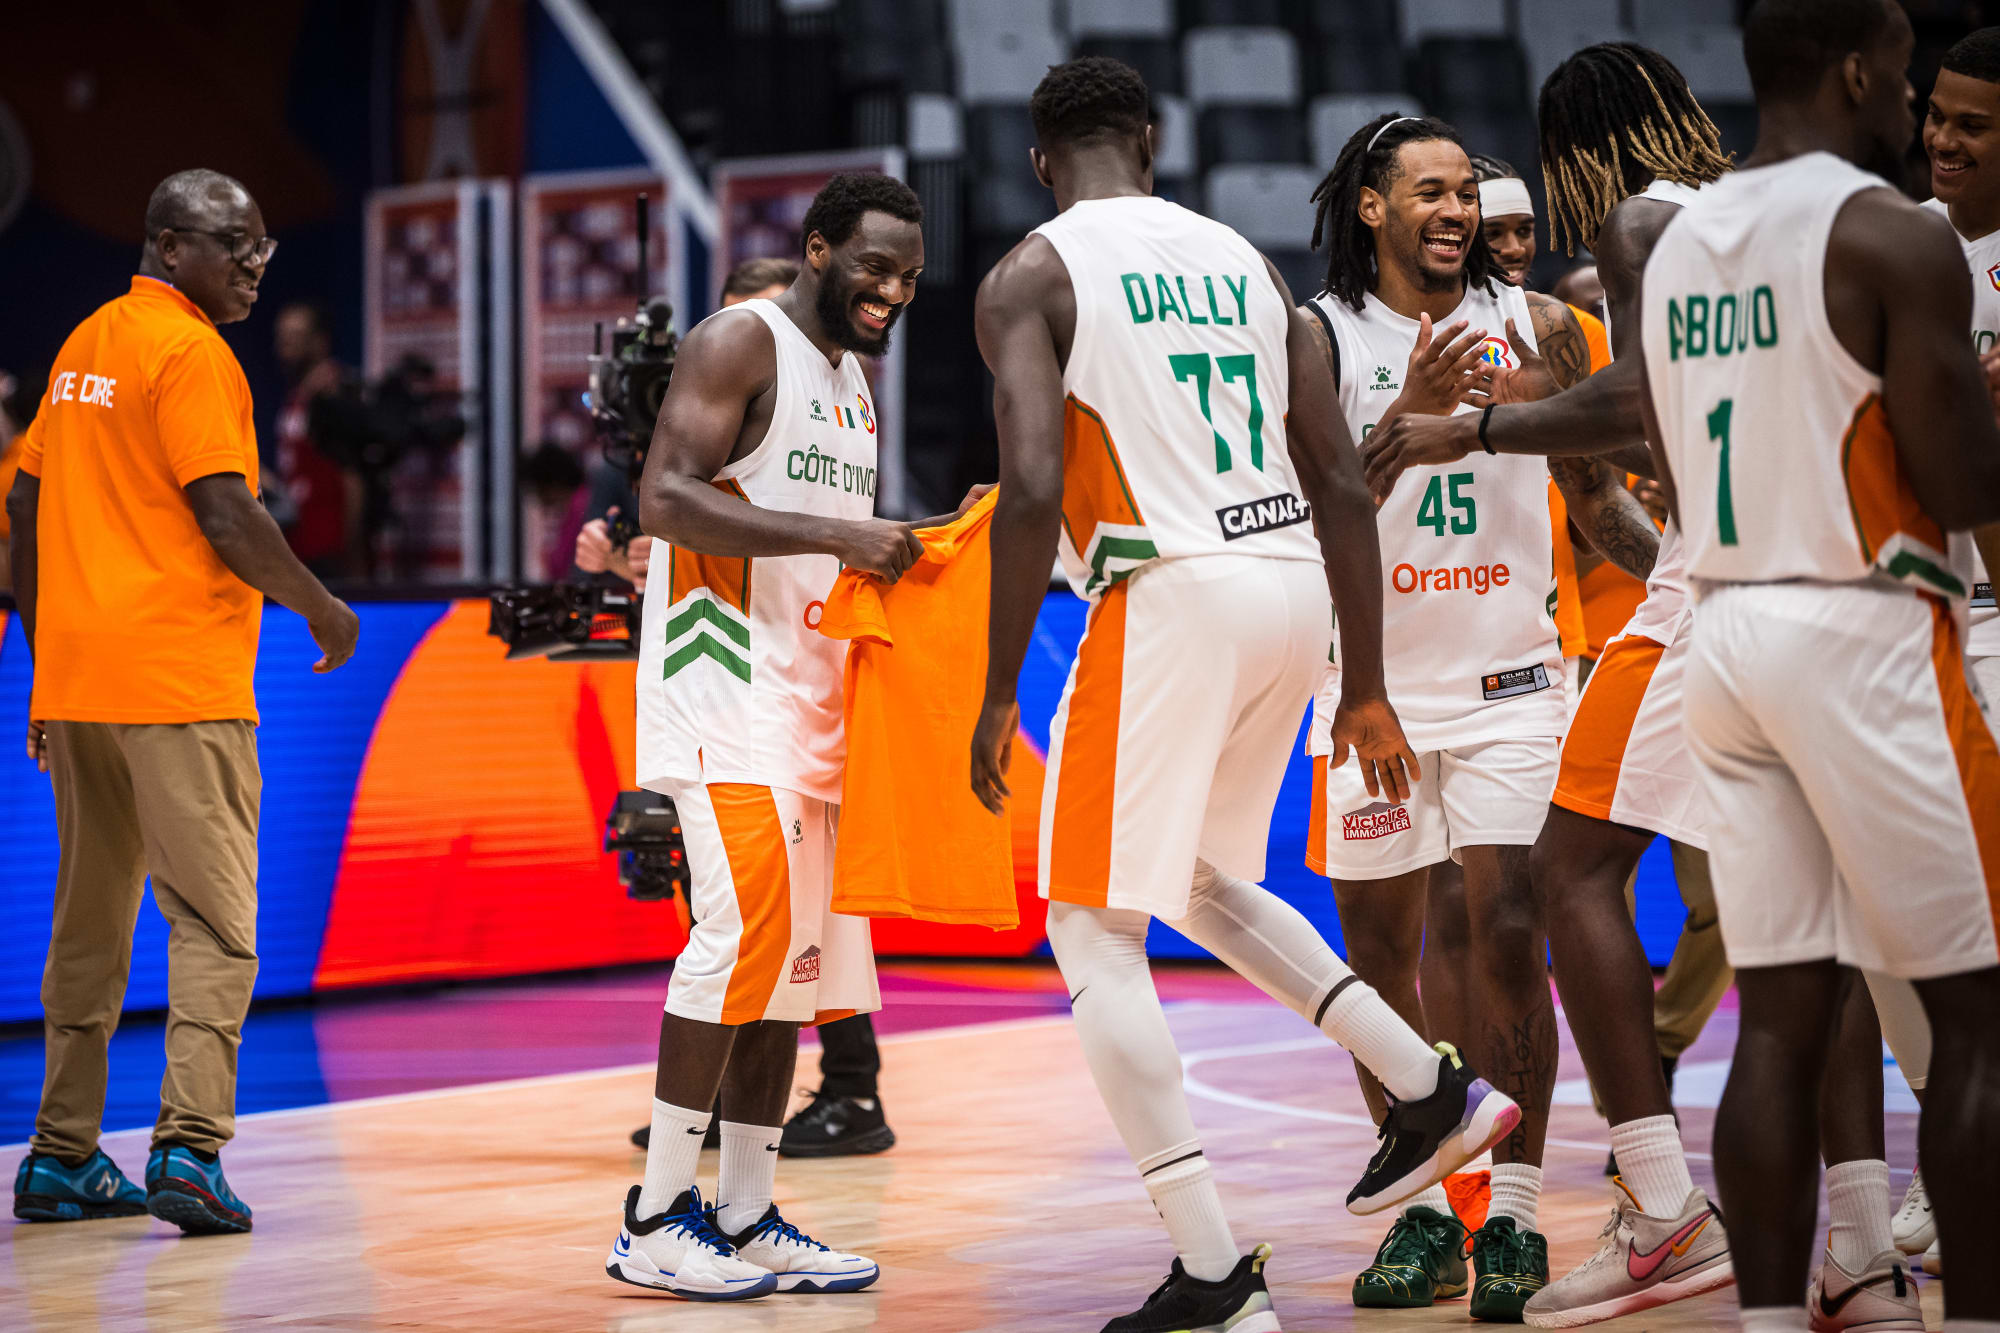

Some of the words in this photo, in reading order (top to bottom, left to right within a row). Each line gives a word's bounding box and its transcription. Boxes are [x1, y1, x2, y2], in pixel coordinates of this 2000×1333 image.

[1120, 272, 1248, 326] DALLY
[1668, 285, 1779, 362] ABOUO
[1167, 352, 1264, 475] 77
[1369, 383, 1400, 391] KELME
[787, 443, 838, 488] CÔTE
[843, 461, 878, 498] D'IVO
[1707, 398, 1739, 546] 1
[1223, 497, 1309, 534] CANAL+
[1417, 472, 1477, 536] 45
[1392, 563, 1510, 596] Orange
[1342, 807, 1407, 830] Victoire
[1345, 819, 1409, 838] IMMOBILIER
